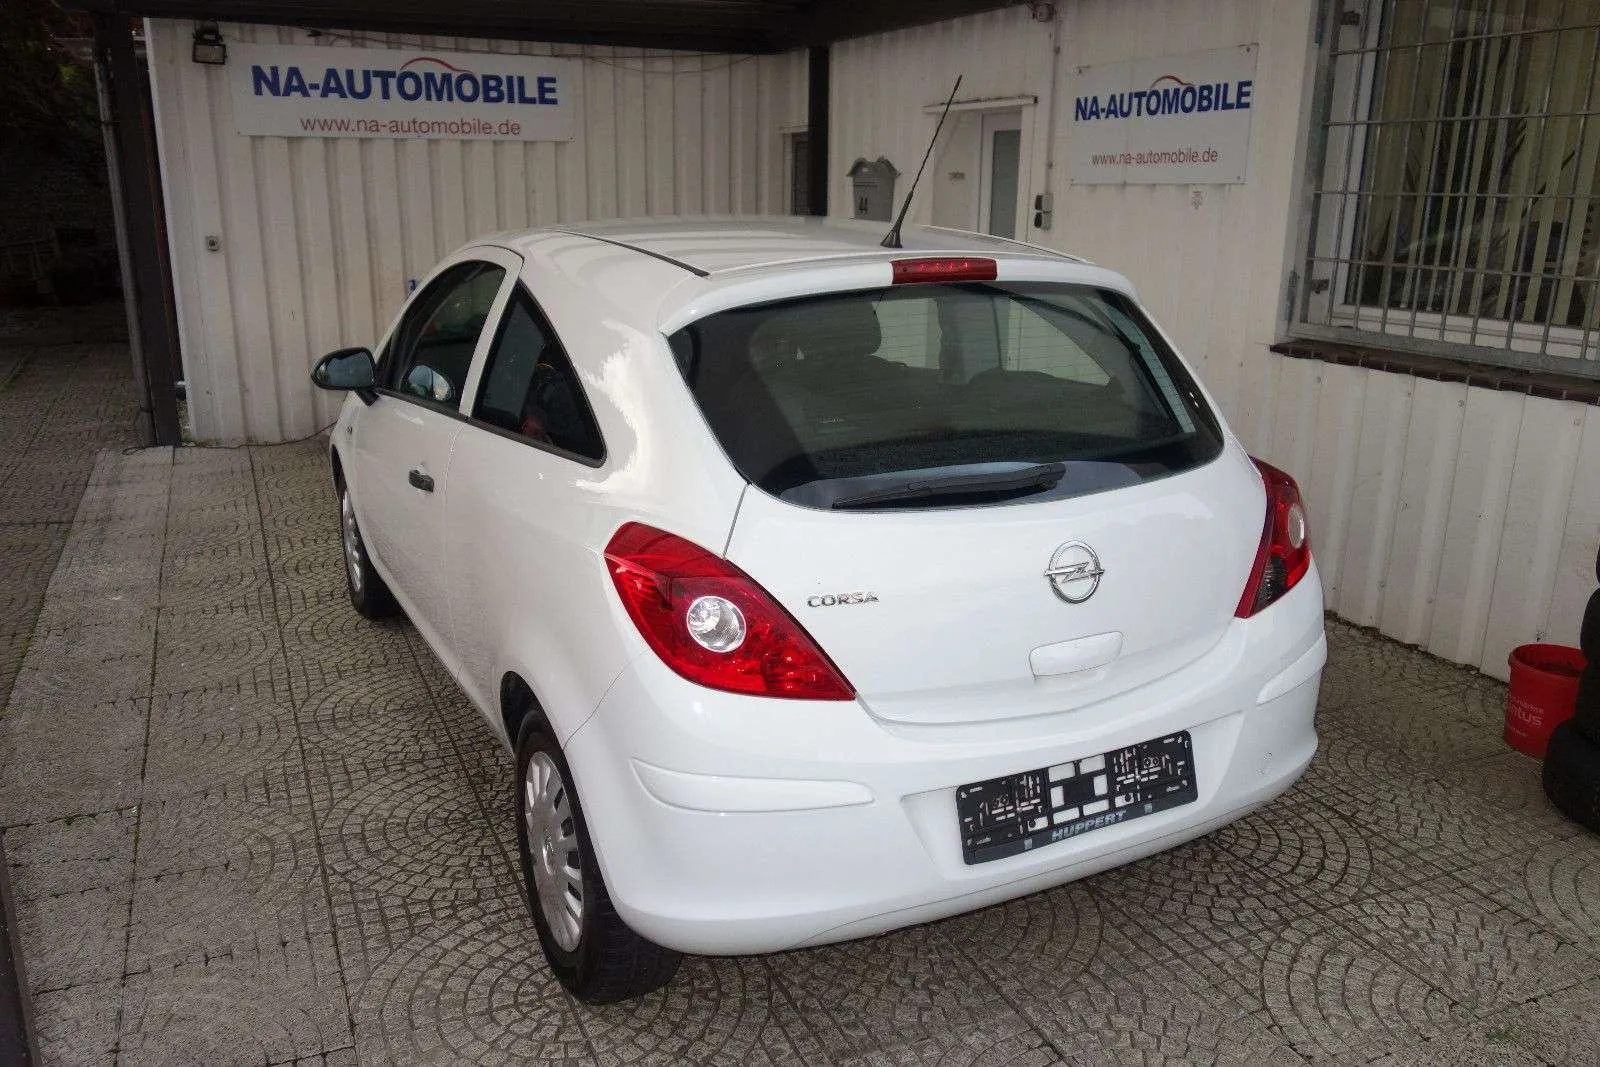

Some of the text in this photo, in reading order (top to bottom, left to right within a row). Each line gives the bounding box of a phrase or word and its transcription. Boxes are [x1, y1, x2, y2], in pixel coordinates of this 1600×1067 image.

[252, 65, 558, 104] NA-AUTOMOBILE
[1075, 80, 1252, 121] NA-AUTOMOBILE
[300, 117, 521, 137] www.na-automobile.de
[1091, 147, 1218, 166] www.na-automobile.de
[807, 592, 878, 608] CORSA
[1051, 809, 1126, 840] HUPPERT
